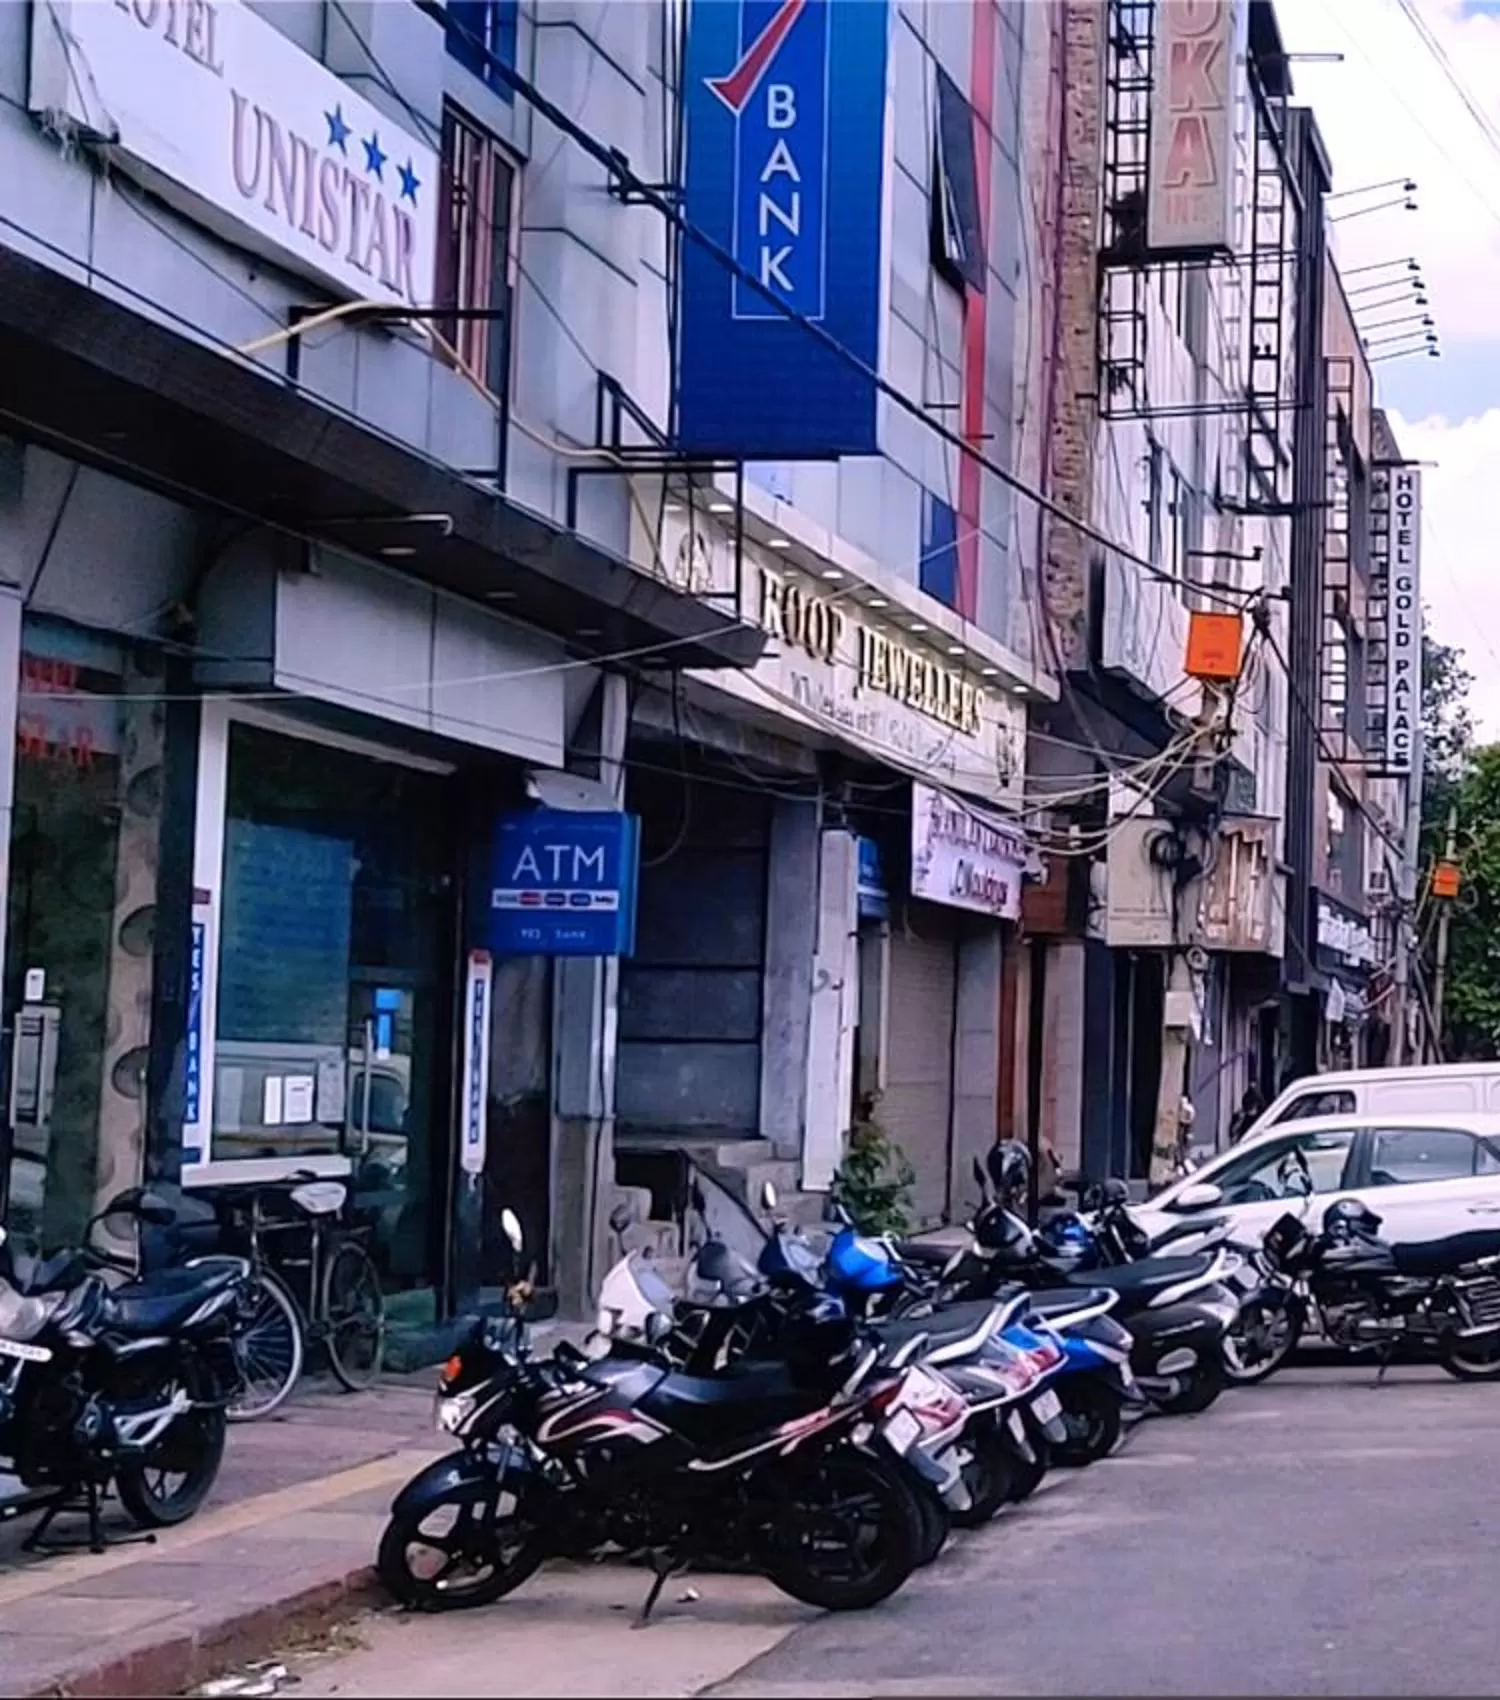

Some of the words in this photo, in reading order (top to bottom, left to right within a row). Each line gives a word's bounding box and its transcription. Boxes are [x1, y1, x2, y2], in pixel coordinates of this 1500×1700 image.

[231, 88, 418, 299] UNISTAR
[759, 84, 801, 292] BANK
[1396, 475, 1412, 564] HOTEL
[758, 566, 847, 666] ROOP
[852, 625, 985, 738] JEWELLERS
[1395, 576, 1412, 647] GOLD
[1393, 660, 1412, 767] PALACE
[511, 844, 605, 882] ATM
